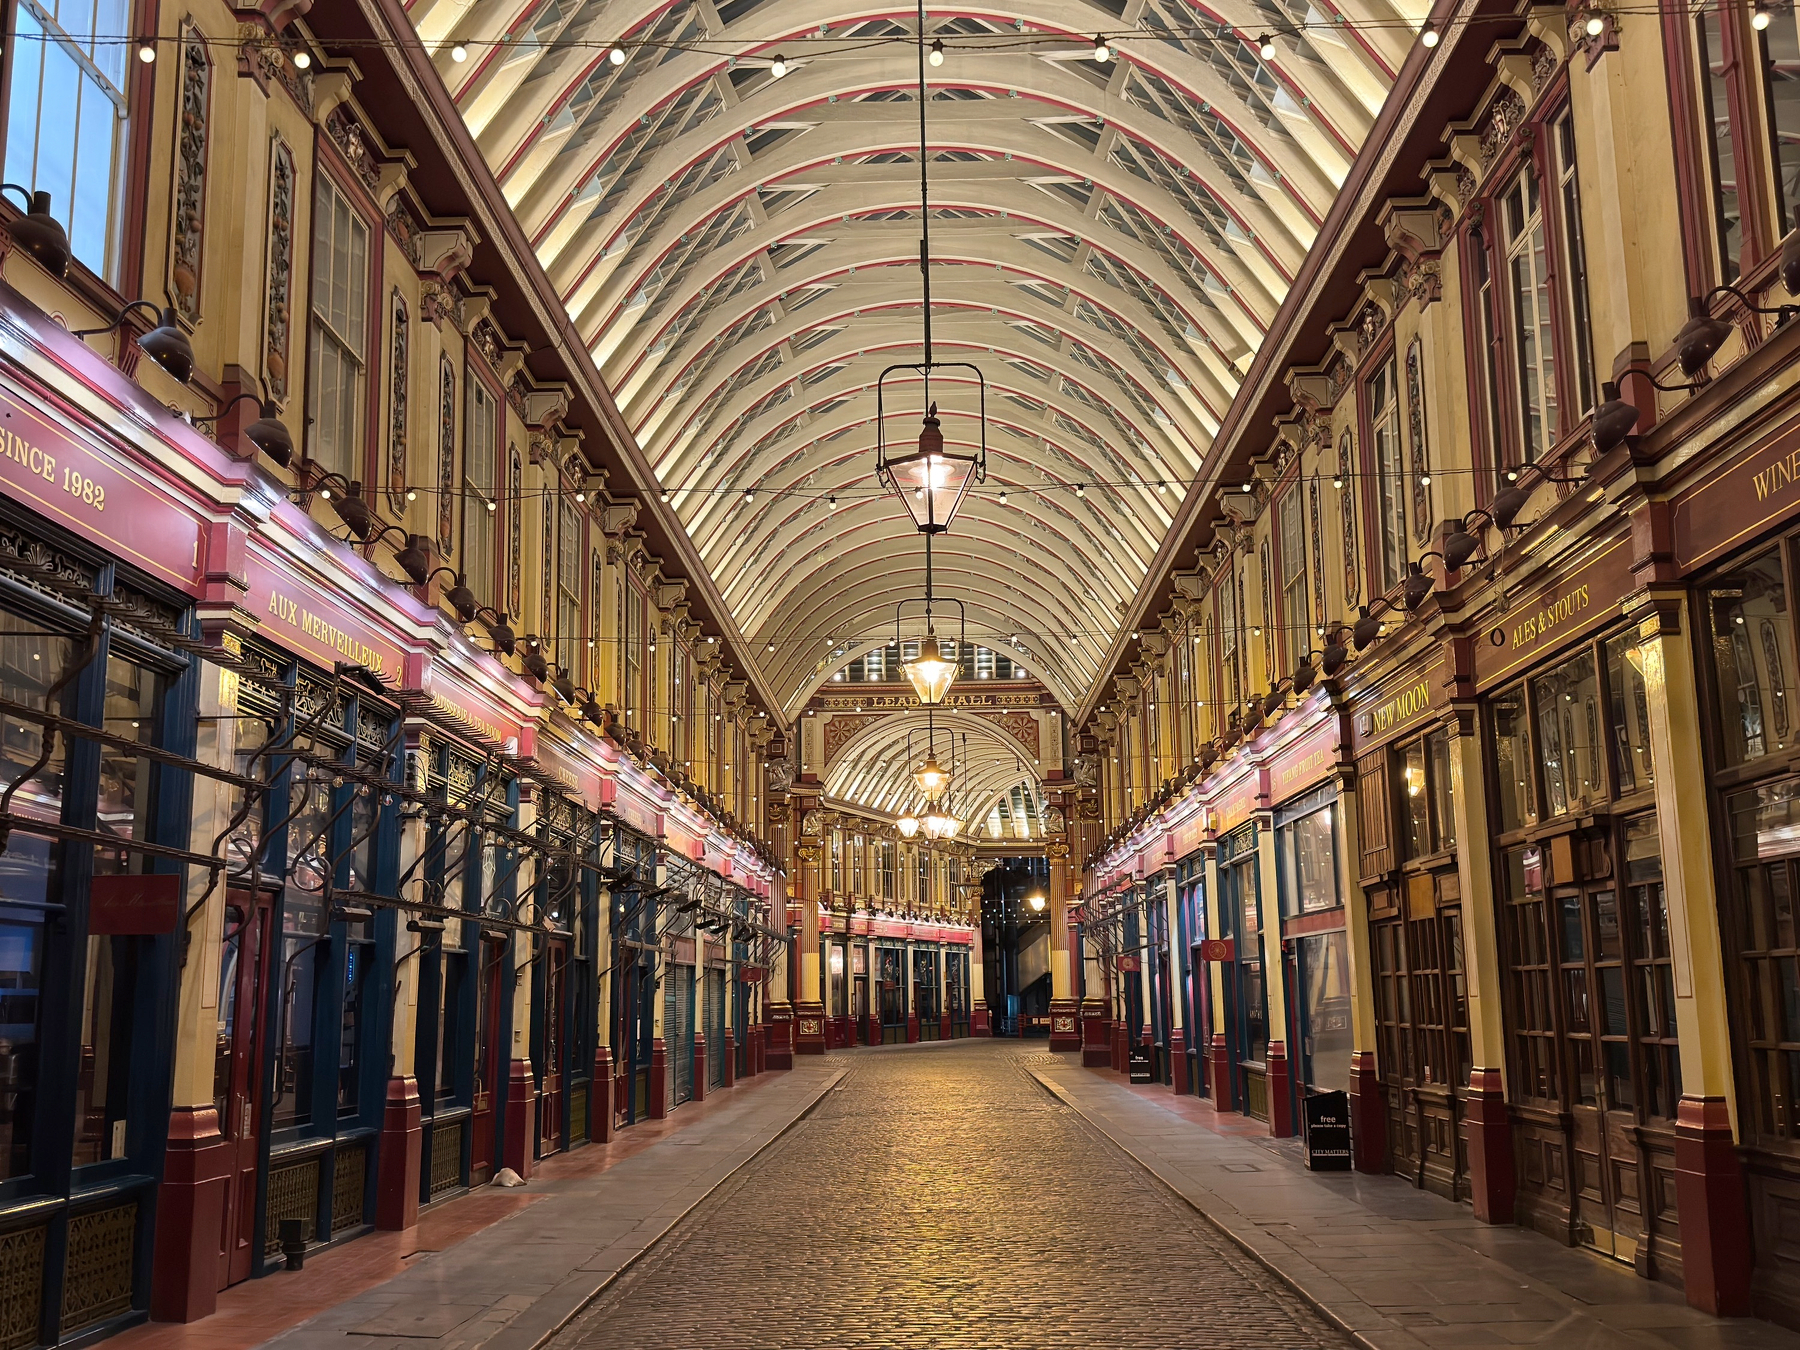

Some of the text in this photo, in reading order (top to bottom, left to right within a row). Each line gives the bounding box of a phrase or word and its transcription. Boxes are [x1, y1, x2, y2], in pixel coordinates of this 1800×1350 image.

[62, 466, 105, 511] 1982
[191, 540, 199, 569] 1
[268, 590, 384, 673] AUX MERVEILLEUX
[1512, 583, 1590, 650] ALES & STOUTS
[396, 665, 403, 688] 2
[1373, 680, 1430, 735] NEW MOON
[1313, 748, 1325, 767] TEA
[1320, 1115, 1336, 1123] free
